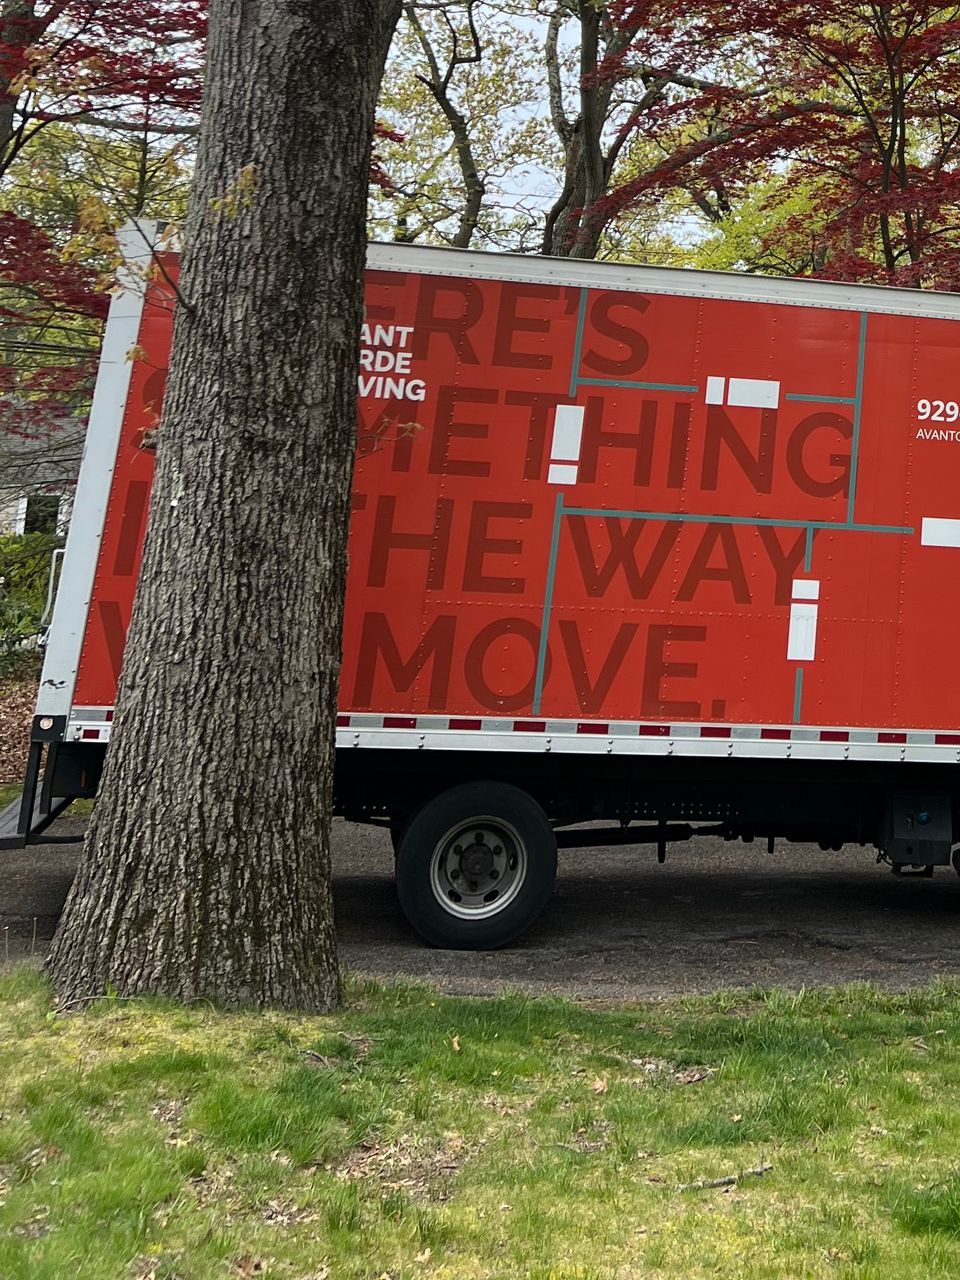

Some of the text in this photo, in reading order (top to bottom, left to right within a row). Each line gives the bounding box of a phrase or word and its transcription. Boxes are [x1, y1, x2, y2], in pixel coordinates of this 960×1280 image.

[359, 350, 413, 374] RDE
[360, 323, 414, 348] ANT
[363, 273, 652, 376] RE'S
[357, 375, 426, 401] VING
[352, 382, 859, 499] METHING
[113, 480, 826, 607] I HE WAY
[352, 611, 726, 720] MOVE.
